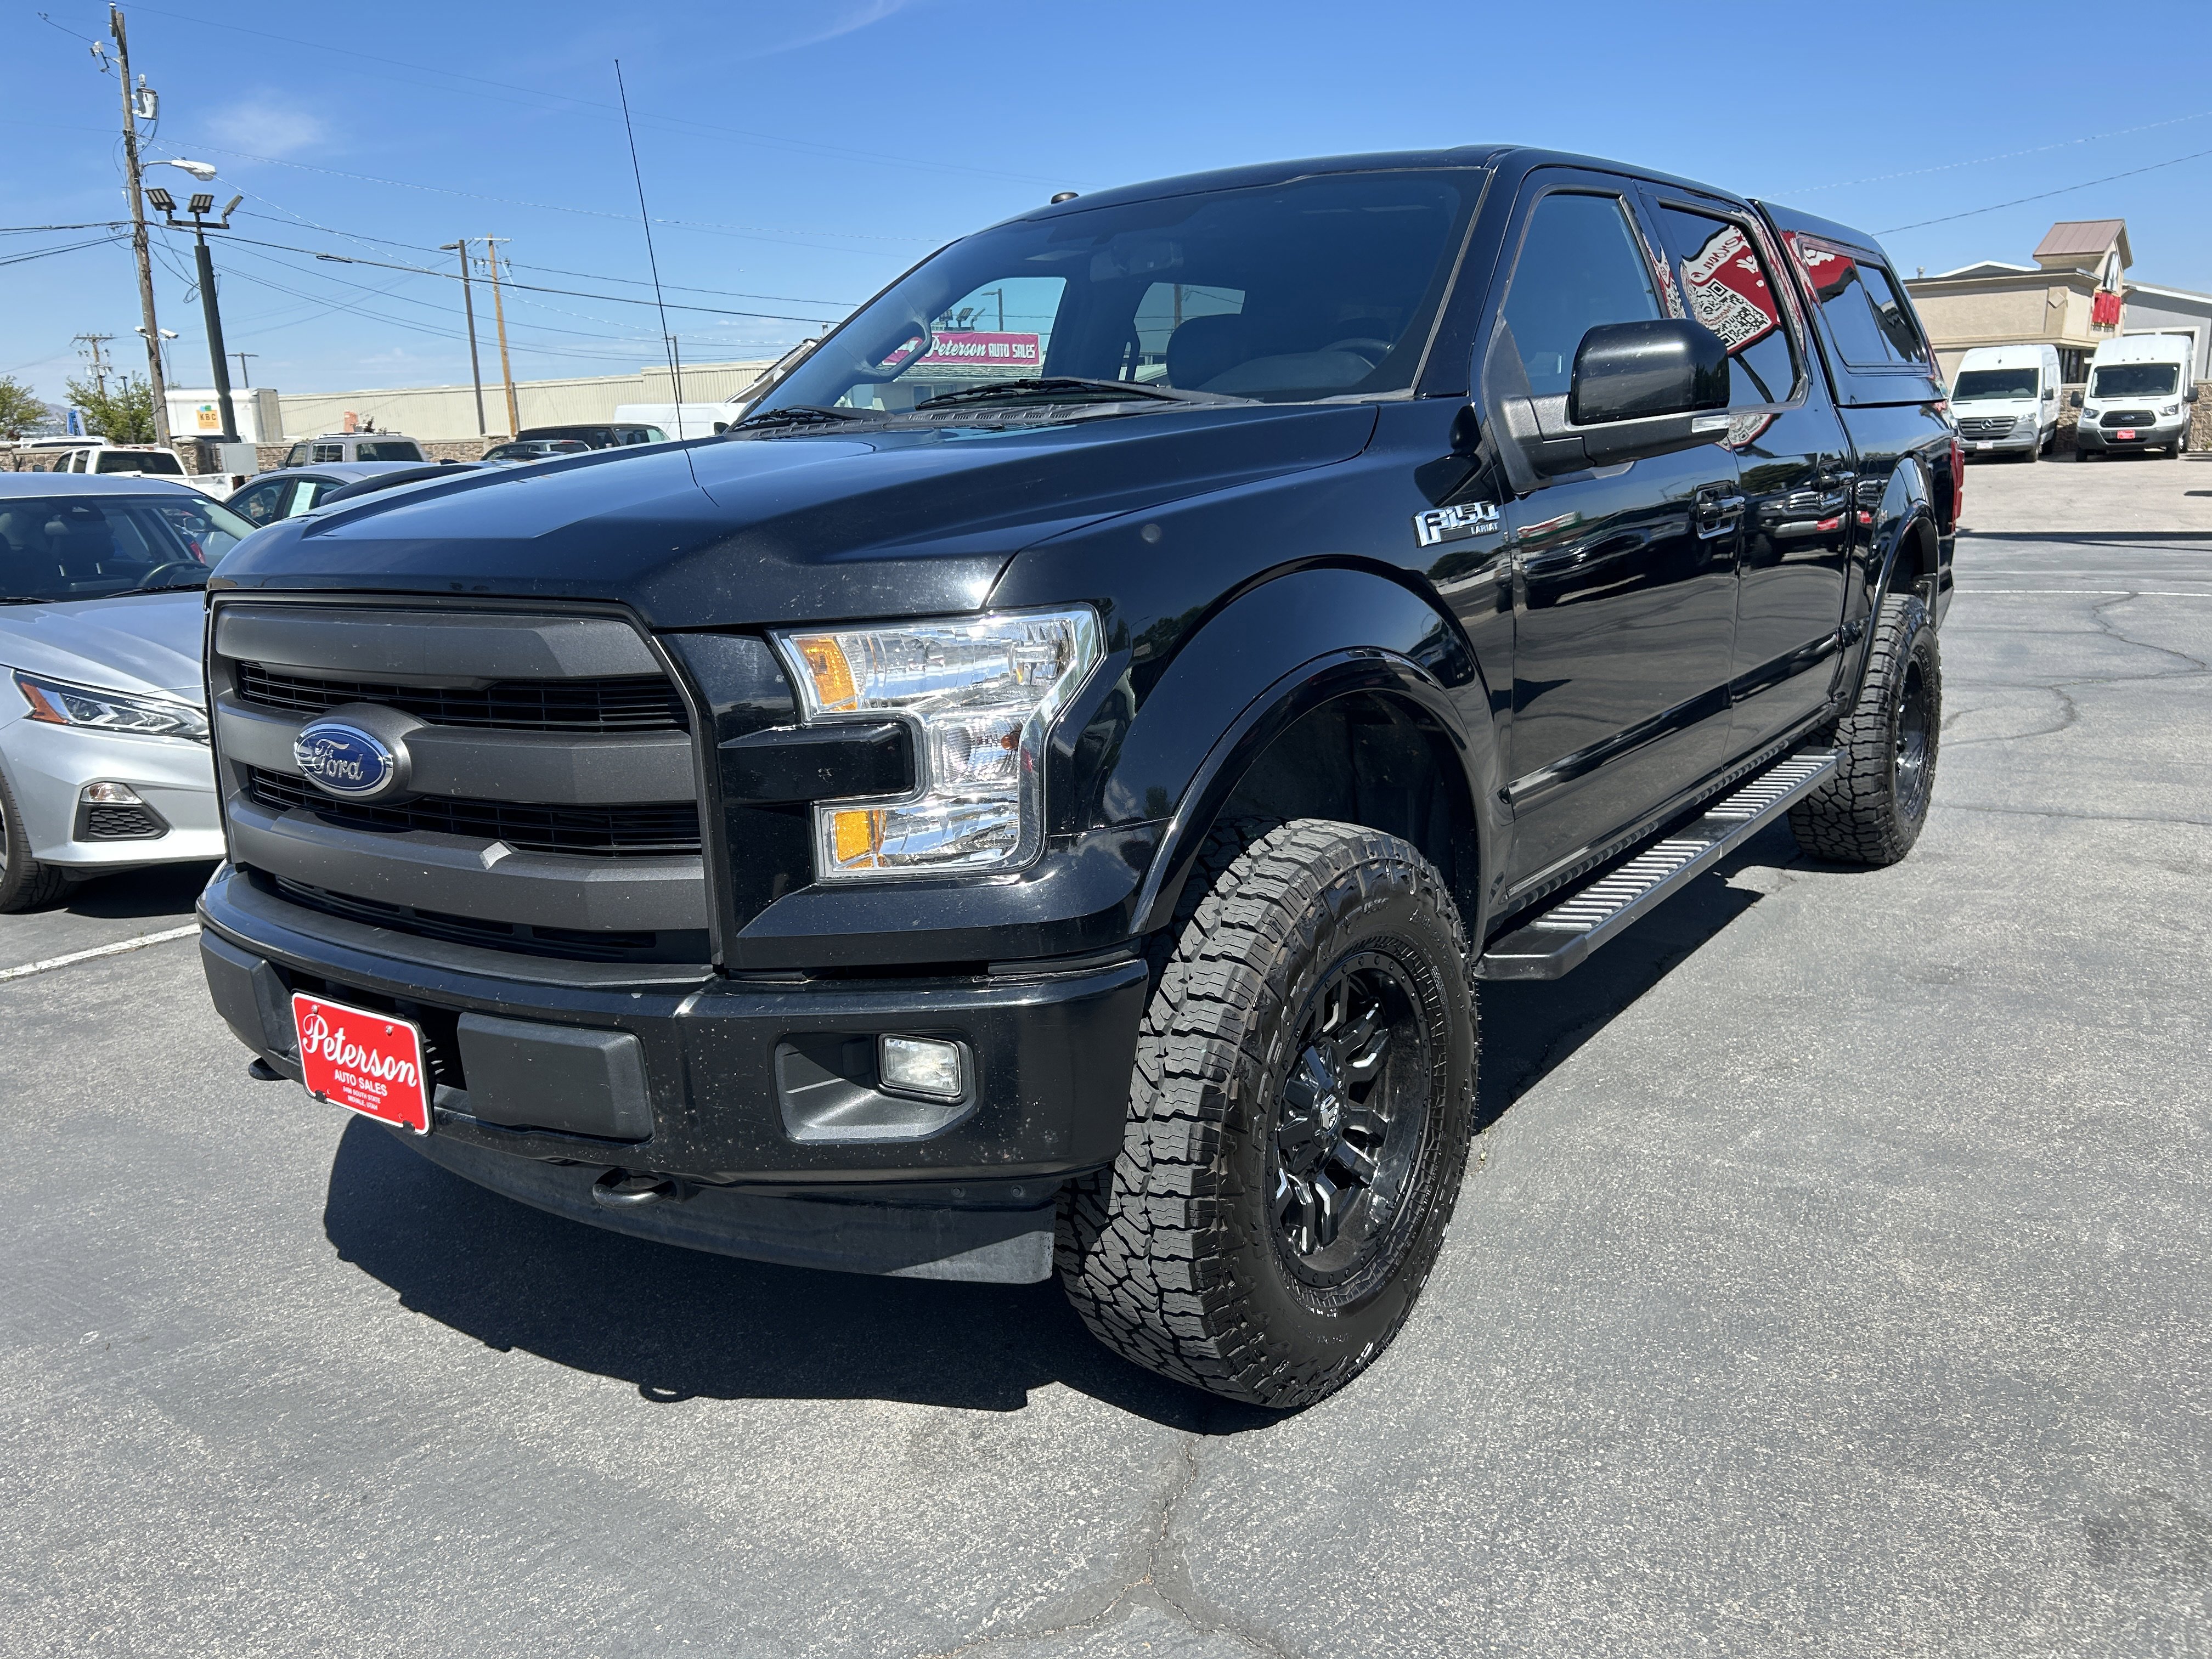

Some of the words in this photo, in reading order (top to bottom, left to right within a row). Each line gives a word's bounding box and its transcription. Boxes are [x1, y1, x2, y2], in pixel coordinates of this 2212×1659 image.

[925, 335, 986, 357] Peterson
[988, 343, 1009, 358] AUTO
[1012, 343, 1036, 359] SALES
[1471, 522, 1498, 535] LARIAT
[314, 738, 364, 781] Ford
[302, 1013, 417, 1087] Peterson
[334, 1069, 357, 1087] AUTO
[358, 1076, 388, 1097] SALES
